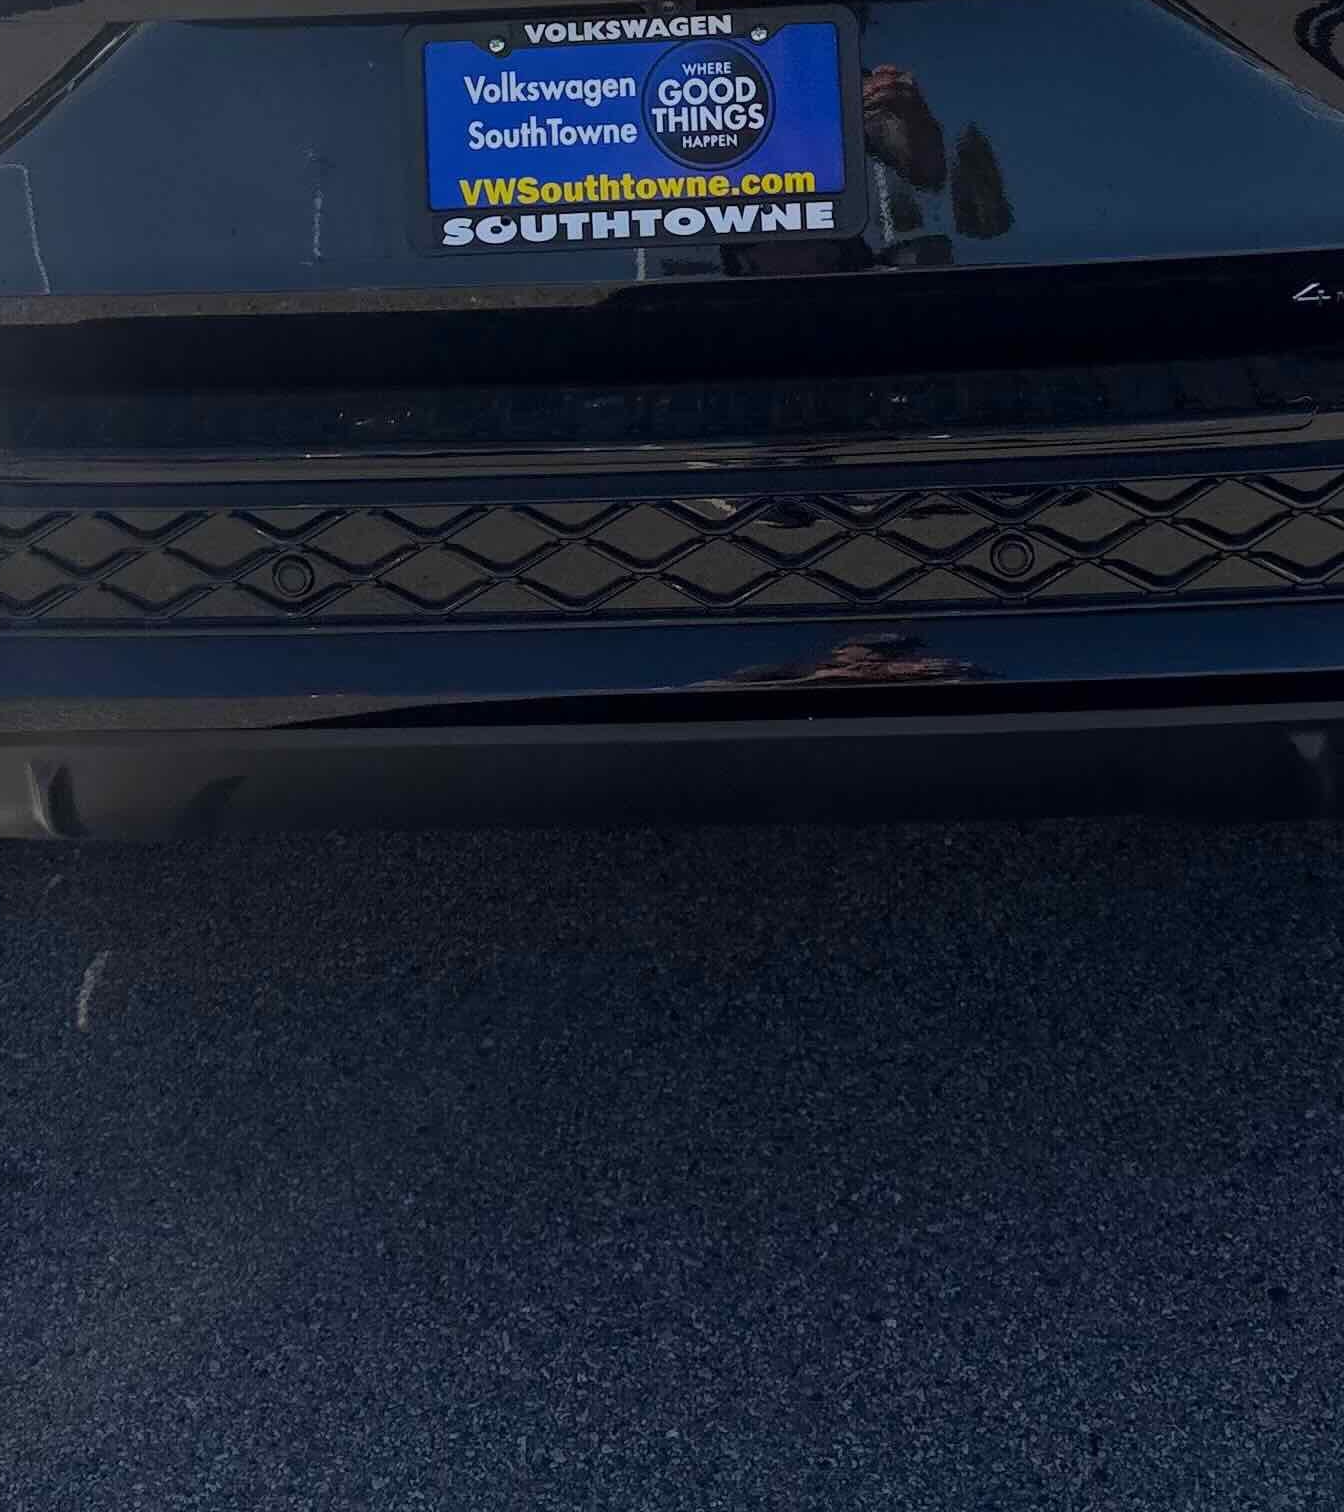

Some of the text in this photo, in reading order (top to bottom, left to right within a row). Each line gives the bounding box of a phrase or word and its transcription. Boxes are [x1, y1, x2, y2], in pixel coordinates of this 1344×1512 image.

[524, 14, 733, 44] VOLKSWAGEN
[682, 62, 732, 76] WHERE
[464, 72, 637, 107] Volkswagen
[658, 76, 756, 106] GOOD
[651, 103, 765, 133] THINGS
[468, 116, 638, 151] SouthTowne
[682, 134, 738, 149] HAPPEN
[459, 170, 816, 207] VWSouthtowne.com
[442, 201, 835, 246] SOUTHTOWNE
